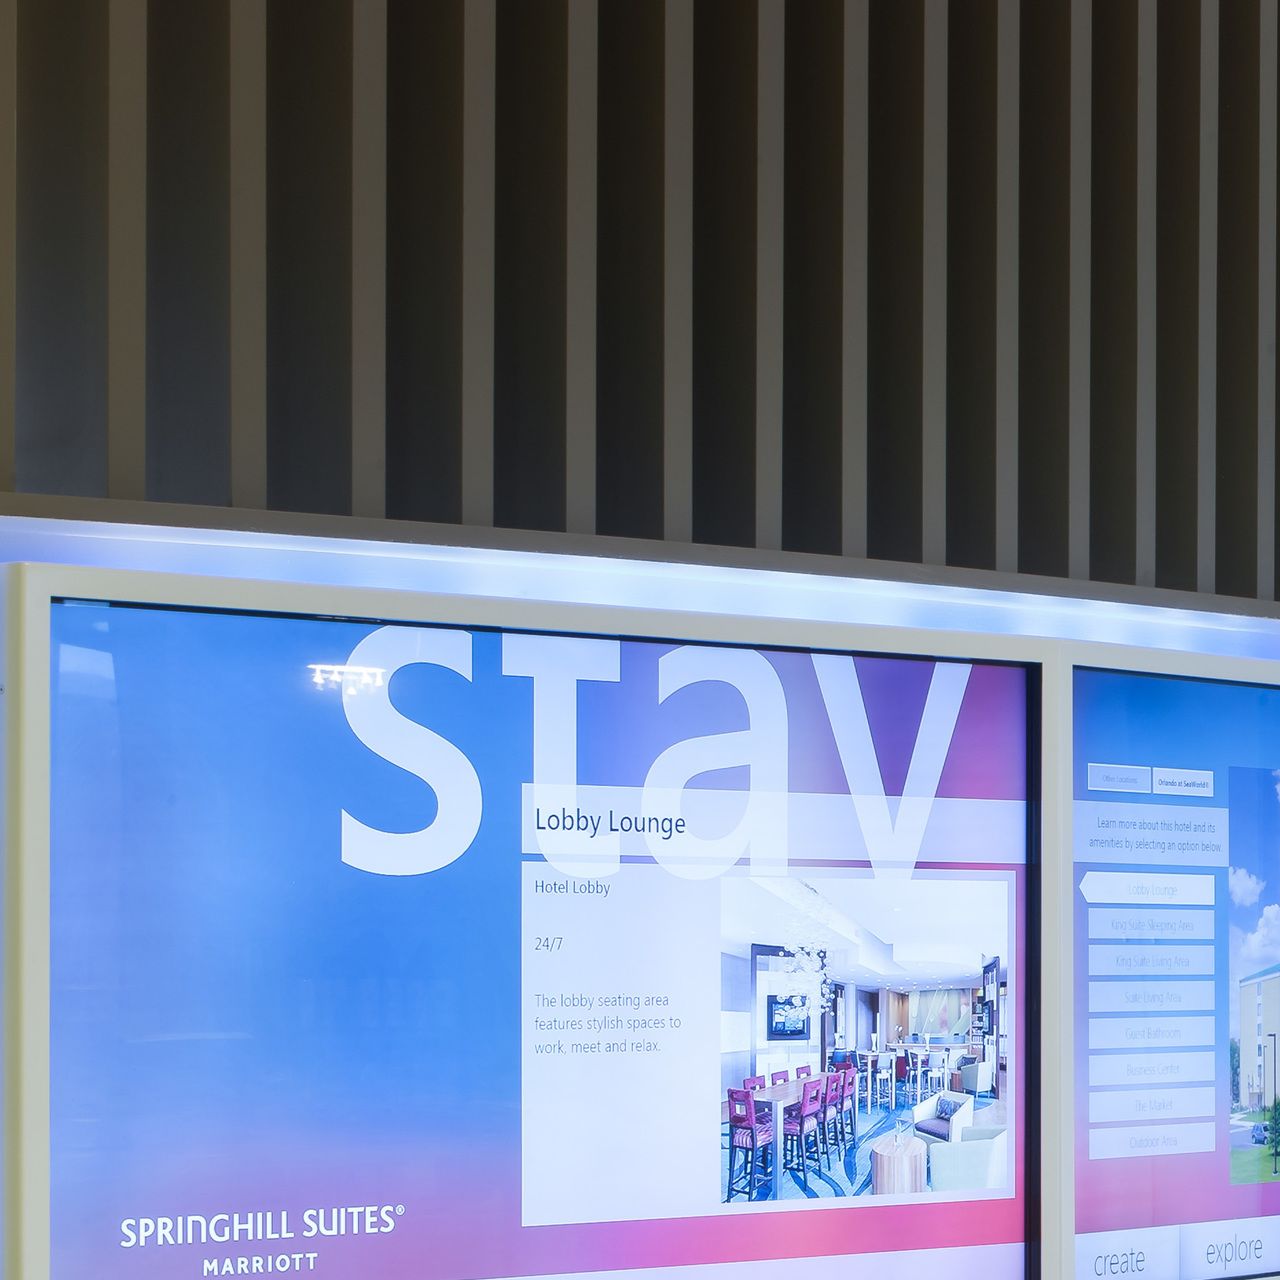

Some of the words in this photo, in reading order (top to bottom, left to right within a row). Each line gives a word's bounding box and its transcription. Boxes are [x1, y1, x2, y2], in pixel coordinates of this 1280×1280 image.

[536, 807, 601, 839] Lobby
[609, 809, 686, 840] Lounge
[1097, 816, 1116, 829] Learn
[1118, 820, 1137, 830] more
[1139, 819, 1159, 832] about
[1160, 819, 1173, 832] this
[1174, 820, 1192, 833] hotel
[1193, 821, 1206, 834] and
[1207, 822, 1216, 834] its
[1089, 838, 1123, 849] amenities
[1124, 838, 1133, 853] by
[1135, 839, 1166, 854] selecting
[1167, 842, 1176, 851] an
[1177, 841, 1200, 854] option
[535, 880, 569, 894] Hotel
[572, 880, 611, 898] Lobby
[534, 936, 563, 952] 24/7
[534, 993, 557, 1007] The
[560, 993, 594, 1010] lobby
[598, 992, 640, 1010] seating
[644, 994, 669, 1007] area
[534, 1016, 583, 1031] features
[586, 1015, 623, 1033] stylish
[627, 1017, 666, 1032] spaces
[669, 1016, 682, 1029] to
[534, 1039, 567, 1055] work,
[571, 1040, 602, 1054] meet
[604, 1038, 627, 1053] and
[631, 1038, 662, 1052] relax.
[119, 1211, 295, 1248] SPRINGHILL
[1206, 1235, 1264, 1270] explore
[202, 1252, 319, 1277] MARRIOTT
[1094, 1247, 1146, 1277] create
